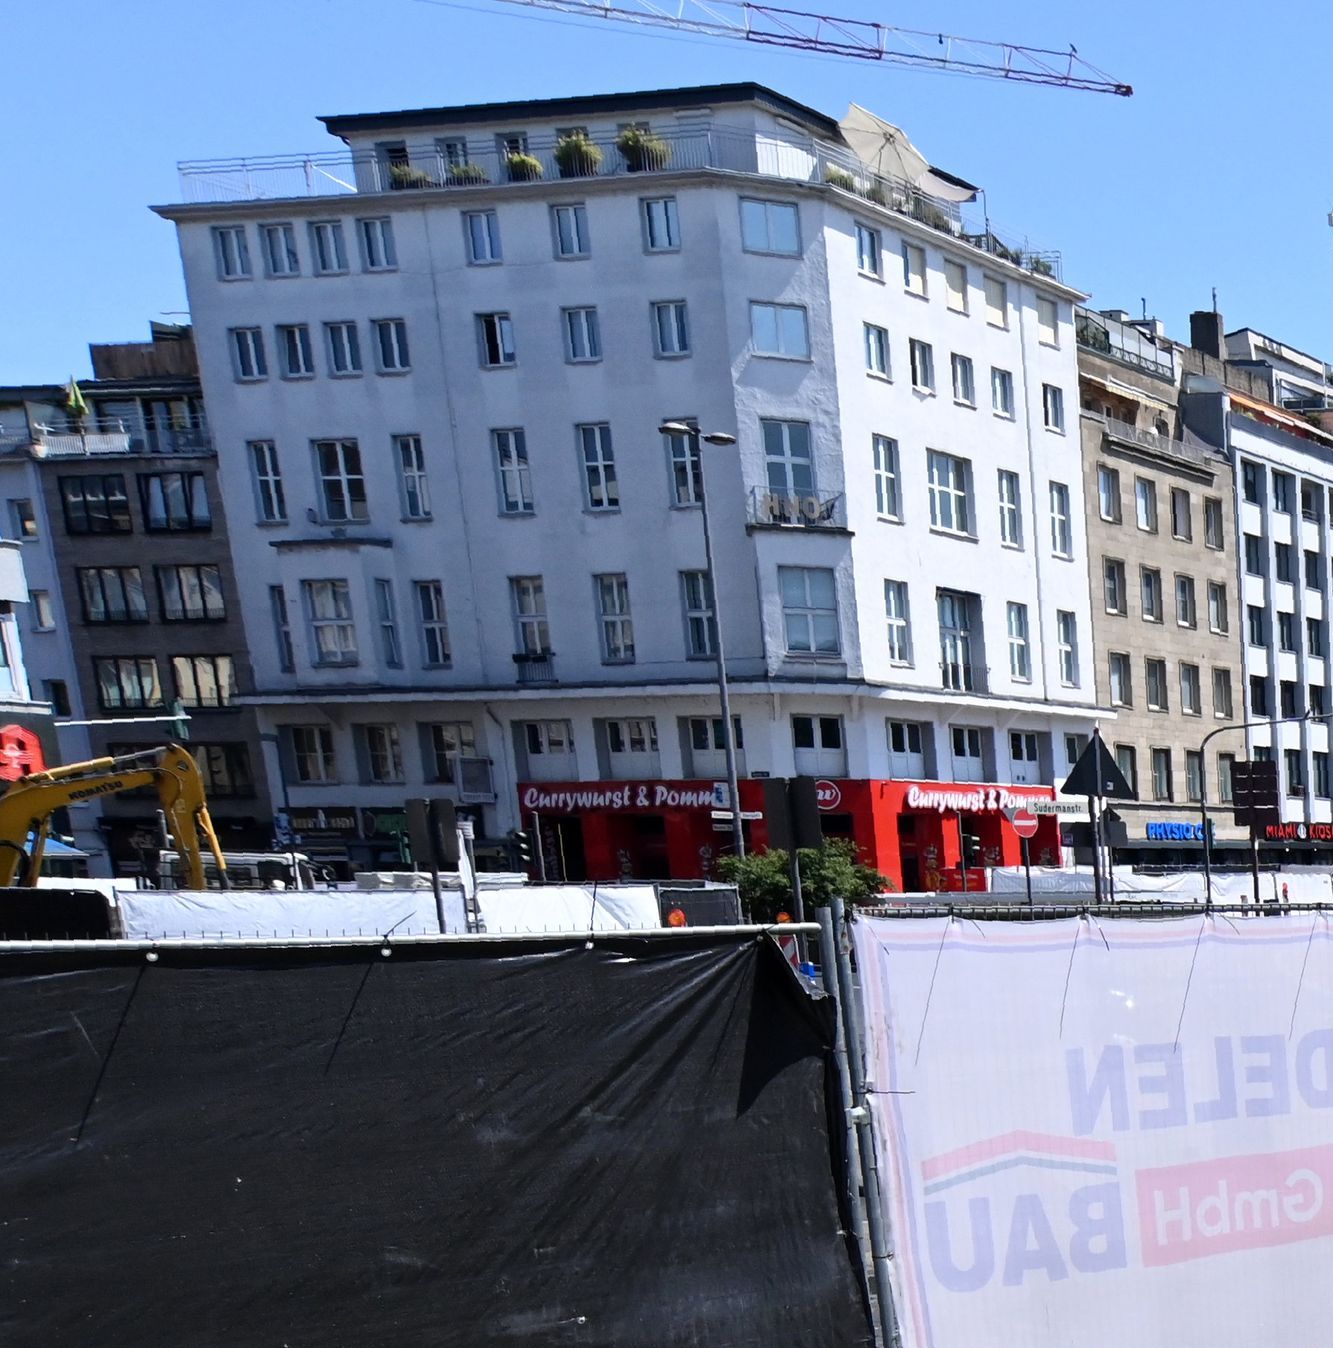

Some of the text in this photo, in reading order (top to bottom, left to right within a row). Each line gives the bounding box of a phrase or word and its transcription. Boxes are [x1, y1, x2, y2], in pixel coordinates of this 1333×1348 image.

[762, 493, 820, 519] HNO
[69, 781, 122, 800] KOMATSU
[523, 785, 630, 811] Currywurst
[635, 785, 650, 807] &
[655, 785, 715, 807] Pomm
[907, 786, 984, 813] Currywurst
[986, 788, 998, 810] &
[1033, 802, 1083, 813] Sudermanstr.
[1147, 822, 1193, 841] PHYSIO
[1266, 824, 1296, 839] MIAMI
